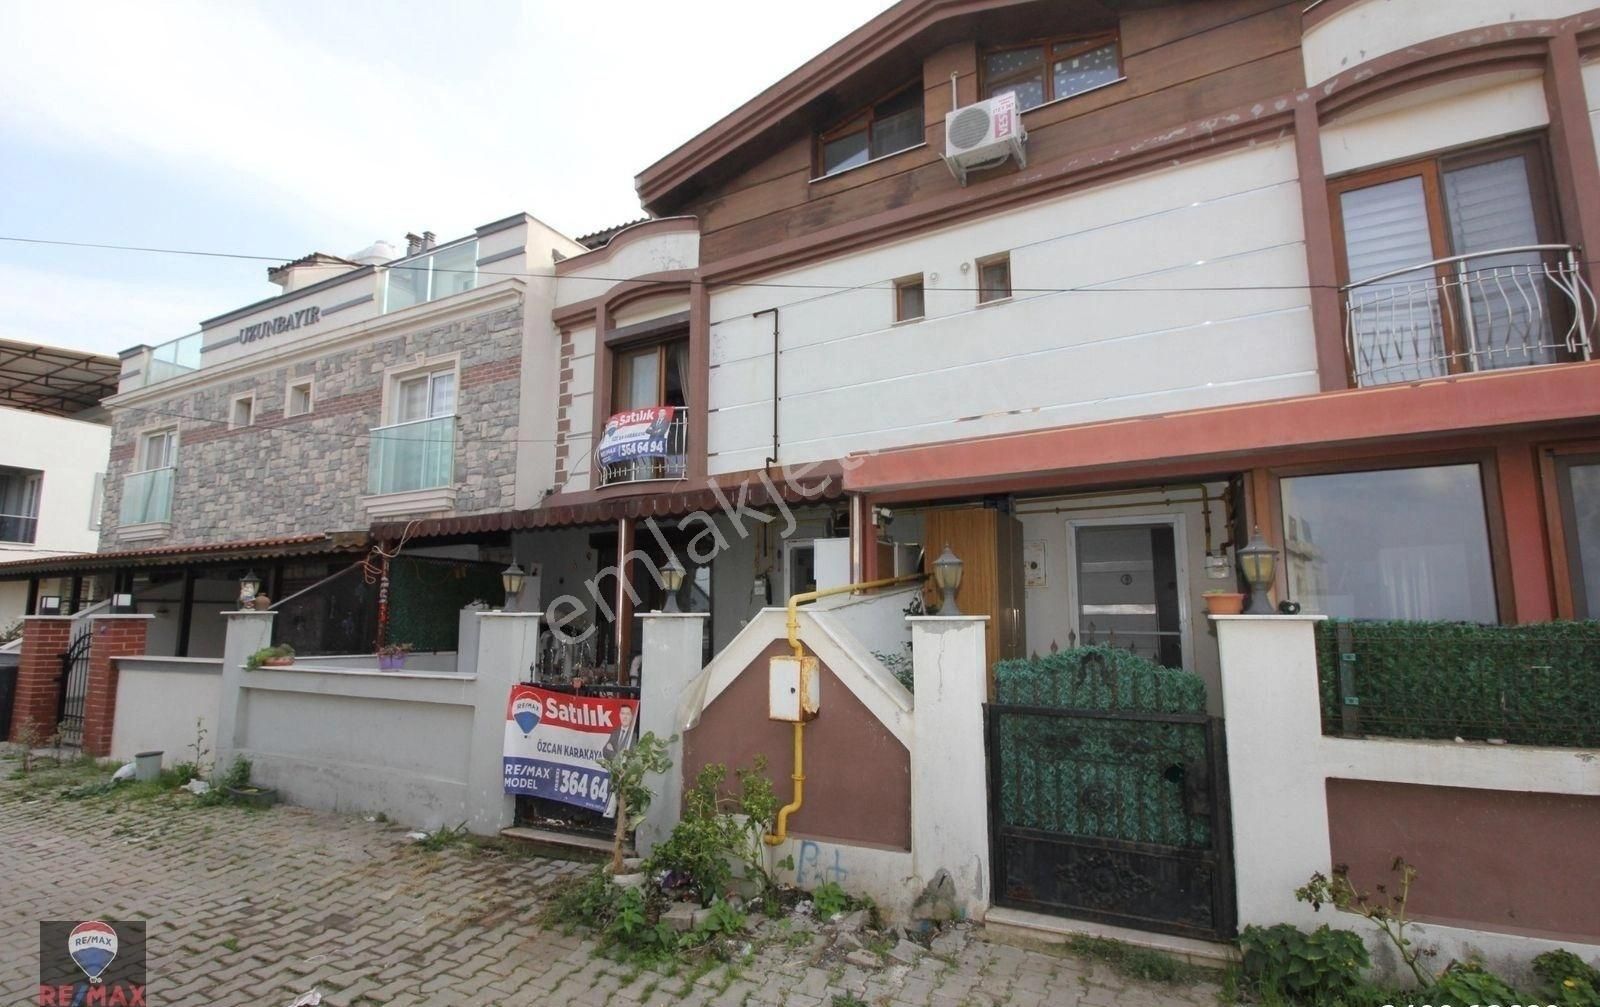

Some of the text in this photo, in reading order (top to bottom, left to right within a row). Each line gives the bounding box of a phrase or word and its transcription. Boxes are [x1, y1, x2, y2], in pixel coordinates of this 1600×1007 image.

[239, 305, 320, 344] UZUNBAYIR
[619, 409, 654, 425] Satılık
[650, 440, 663, 453] 94
[517, 703, 539, 712] RE/MAX
[545, 696, 613, 728] Satılık
[536, 739, 563, 754] ÖZCAN
[504, 764, 551, 779] RE/MAX
[504, 777, 538, 790] MODEL
[560, 769, 589, 797] 364
[590, 776, 609, 803] 64
